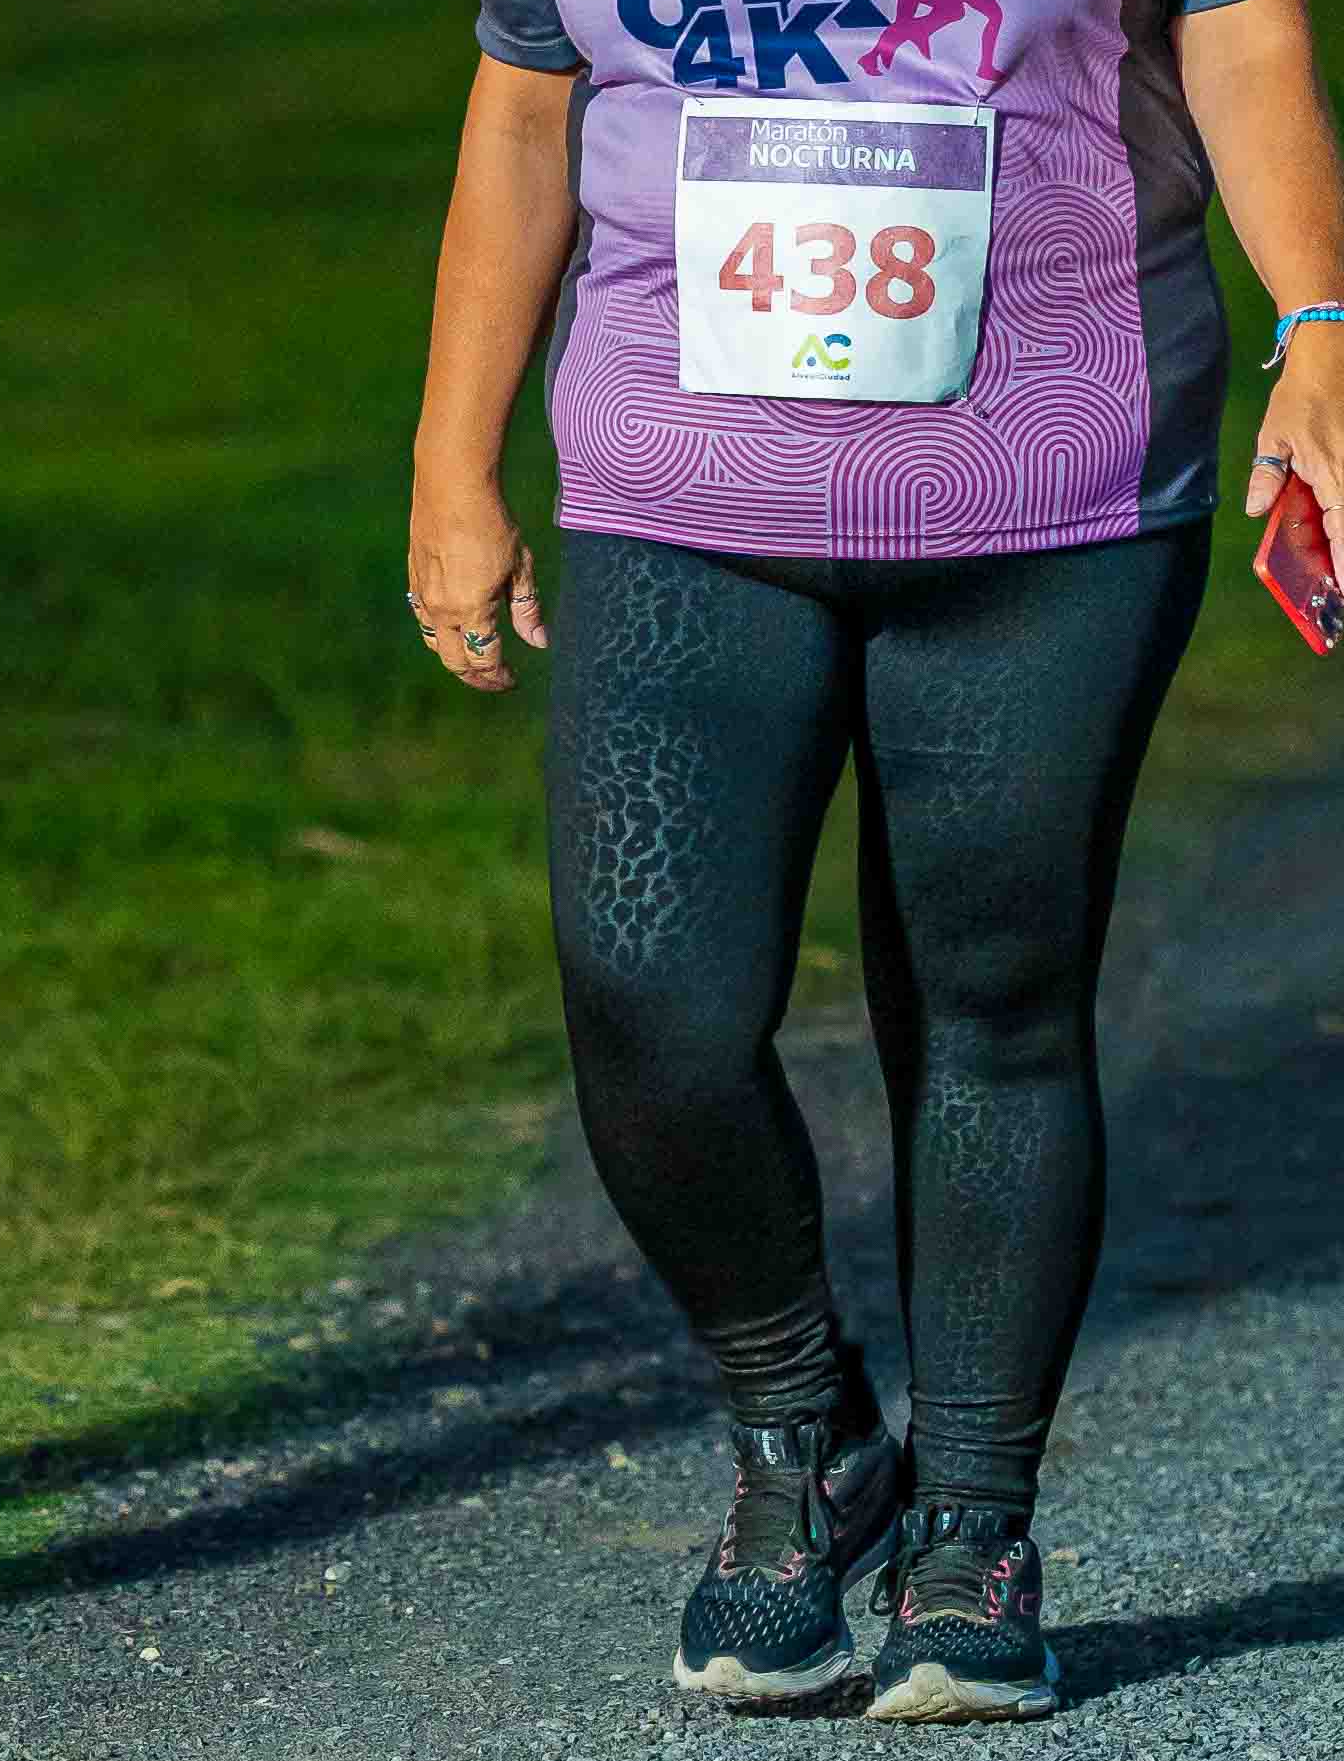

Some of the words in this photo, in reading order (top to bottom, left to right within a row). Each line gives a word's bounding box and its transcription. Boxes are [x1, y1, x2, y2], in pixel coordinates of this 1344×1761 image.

[672, 1, 855, 90] 4K
[749, 143, 918, 172] NOCTURNA
[750, 119, 848, 142] Maratón
[719, 221, 937, 320] 438
